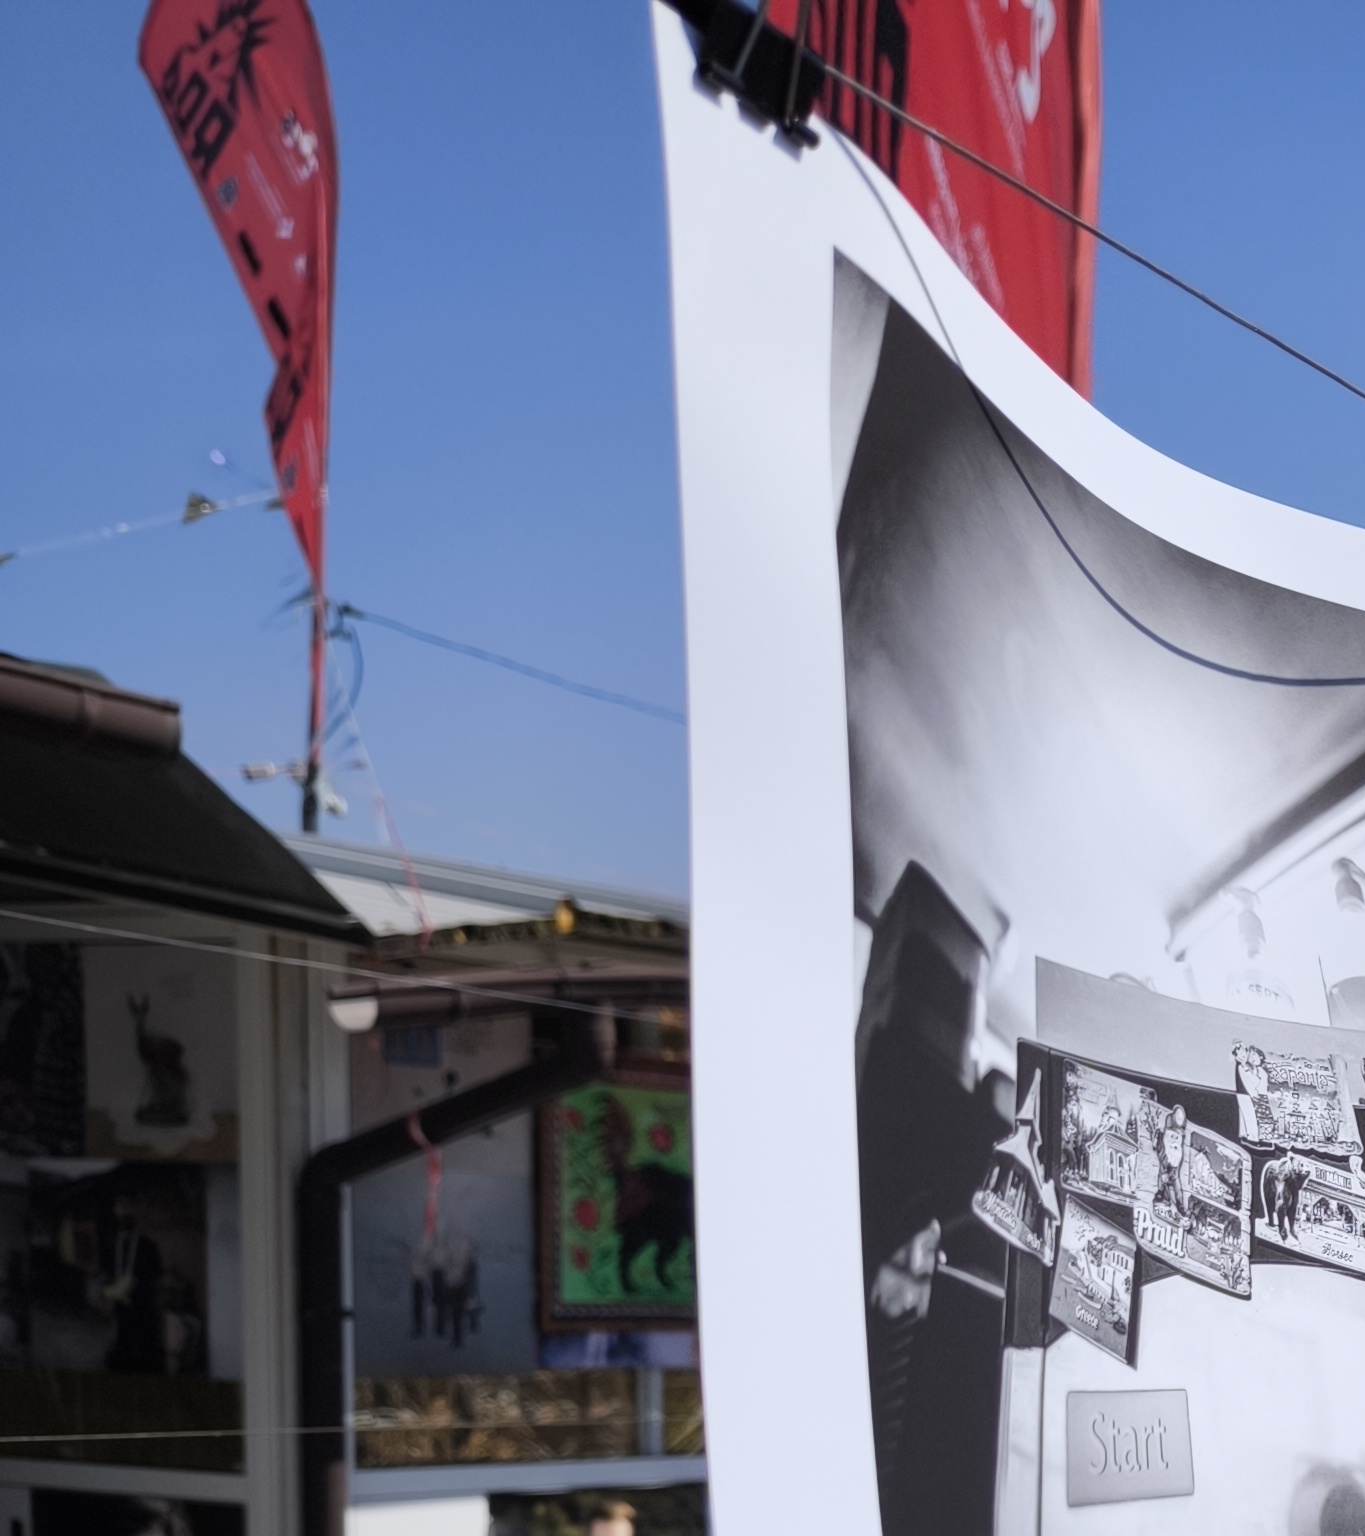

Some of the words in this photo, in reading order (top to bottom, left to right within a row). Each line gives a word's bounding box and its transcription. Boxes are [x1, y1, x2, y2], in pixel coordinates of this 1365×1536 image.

[1321, 1241, 1354, 1264] Borsec
[1075, 1304, 1100, 1330] Greece
[1089, 1412, 1170, 1477] Start
